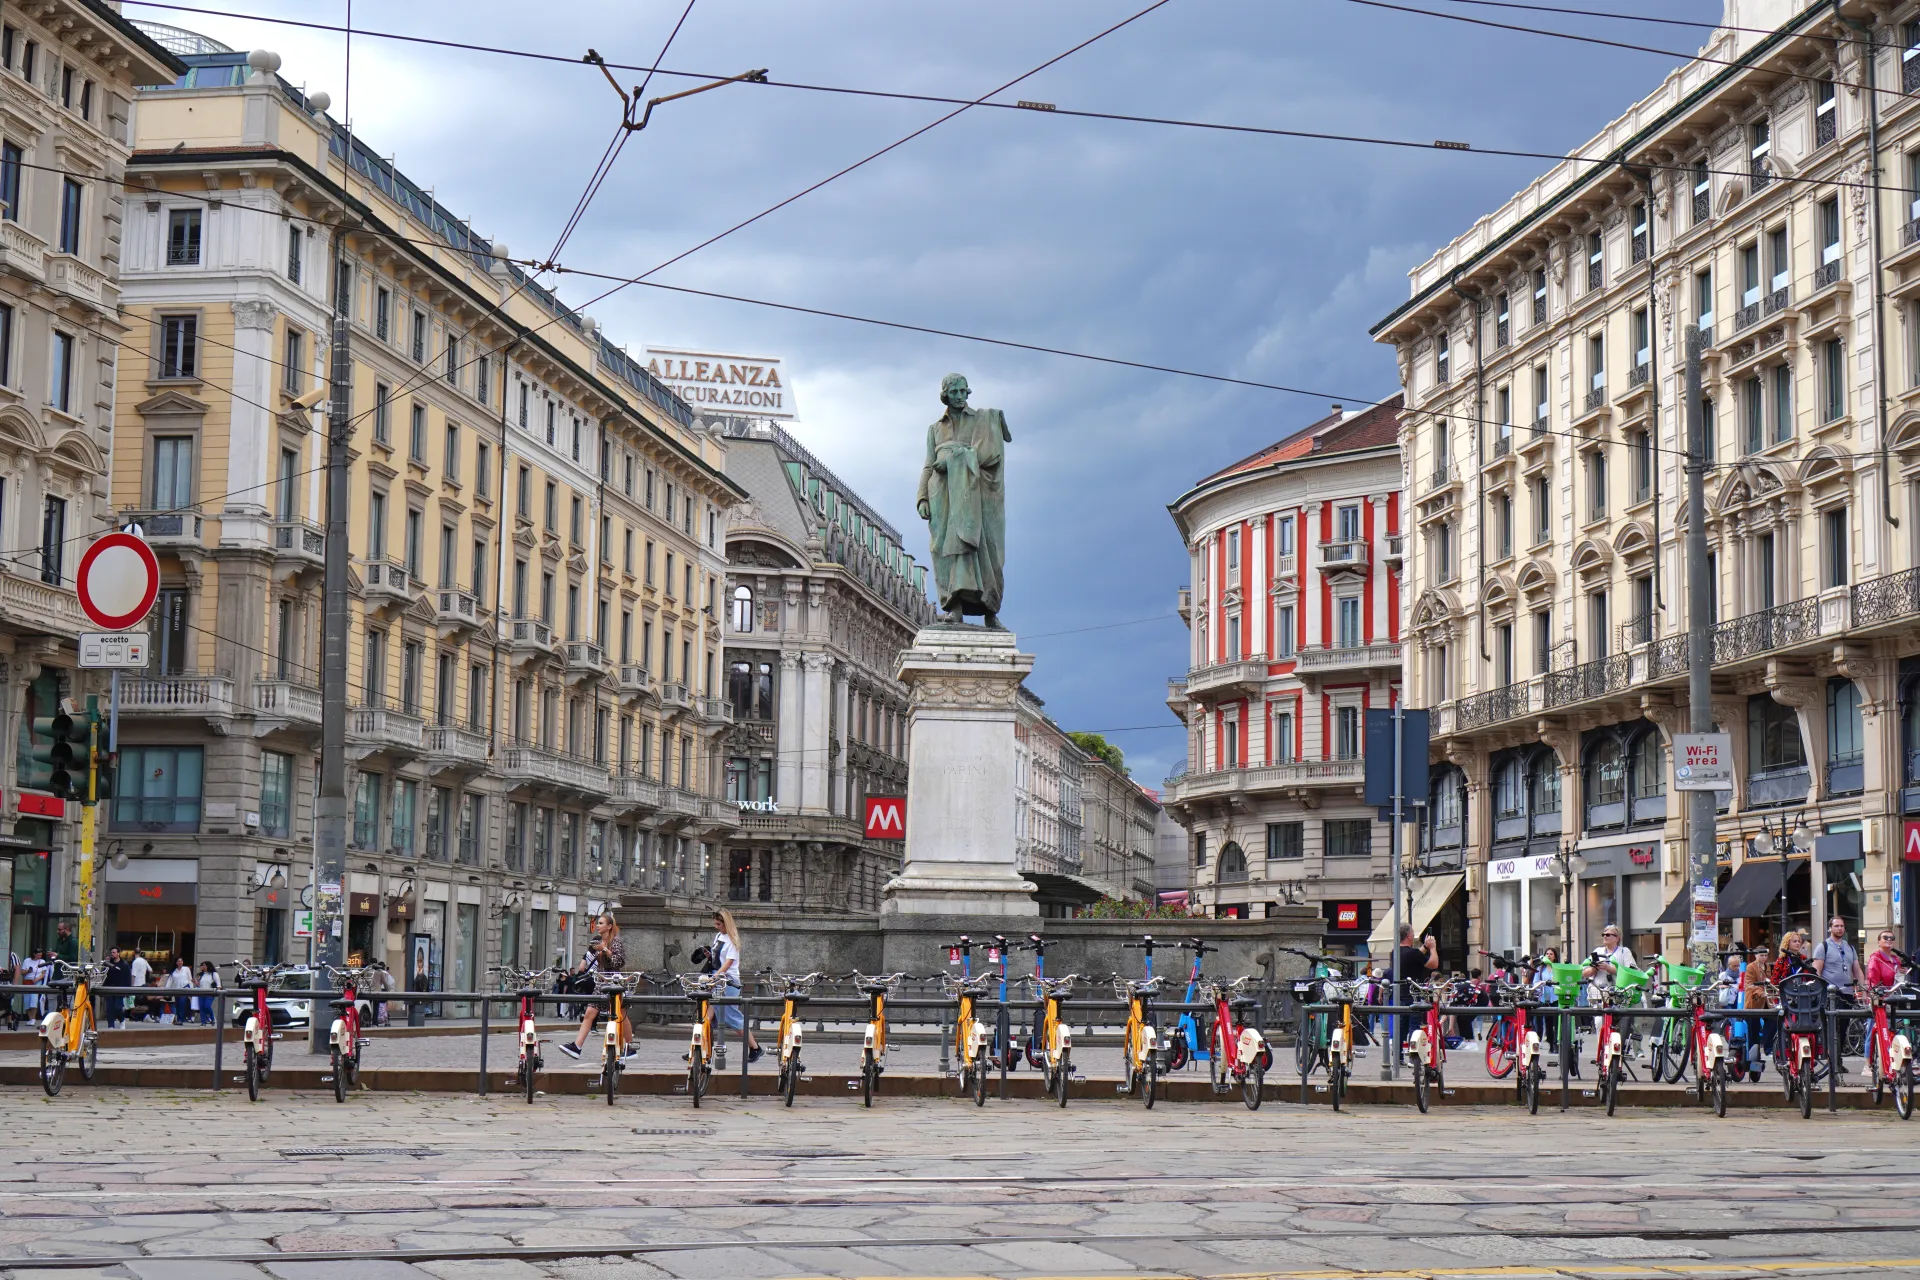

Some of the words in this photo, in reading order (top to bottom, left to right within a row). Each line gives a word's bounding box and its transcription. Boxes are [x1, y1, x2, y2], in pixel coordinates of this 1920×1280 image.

[648, 358, 782, 387] ALLEANZA
[100, 635, 129, 644] eccetto
[1686, 745, 1718, 756] Wi-Fi
[1686, 757, 1718, 766] area
[867, 804, 903, 831] M
[1496, 861, 1515, 874] KIKO
[1339, 911, 1356, 921] LEGO
